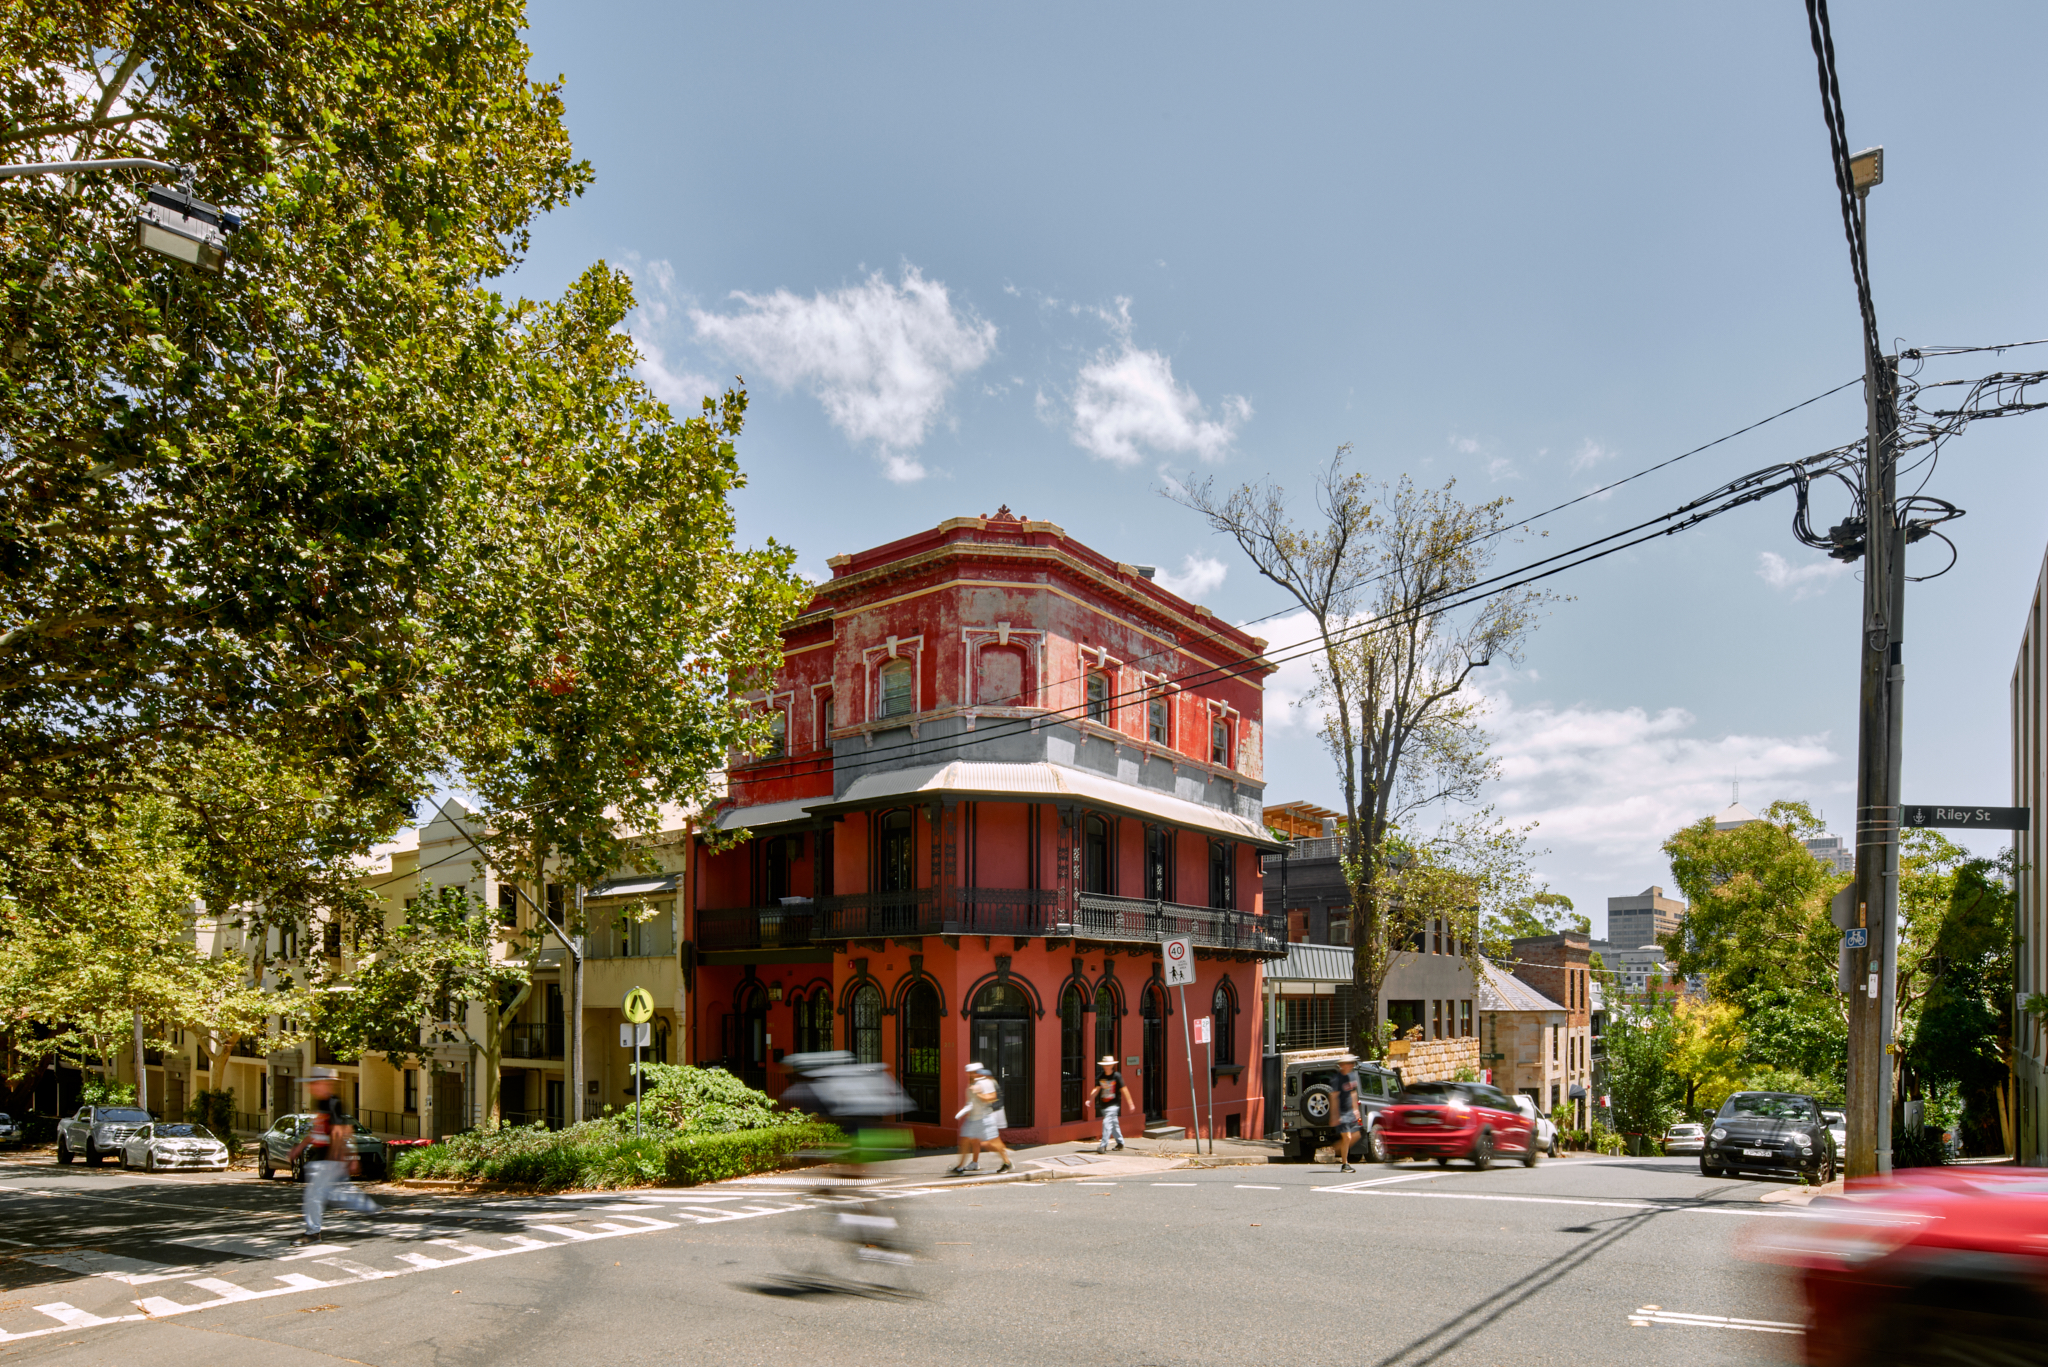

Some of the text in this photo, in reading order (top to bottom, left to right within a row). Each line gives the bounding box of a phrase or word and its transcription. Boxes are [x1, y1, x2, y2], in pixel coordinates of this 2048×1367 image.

[1936, 808, 1990, 824] Riley St
[1171, 946, 1182, 955] 40
[1202, 1020, 1209, 1028] 2P
